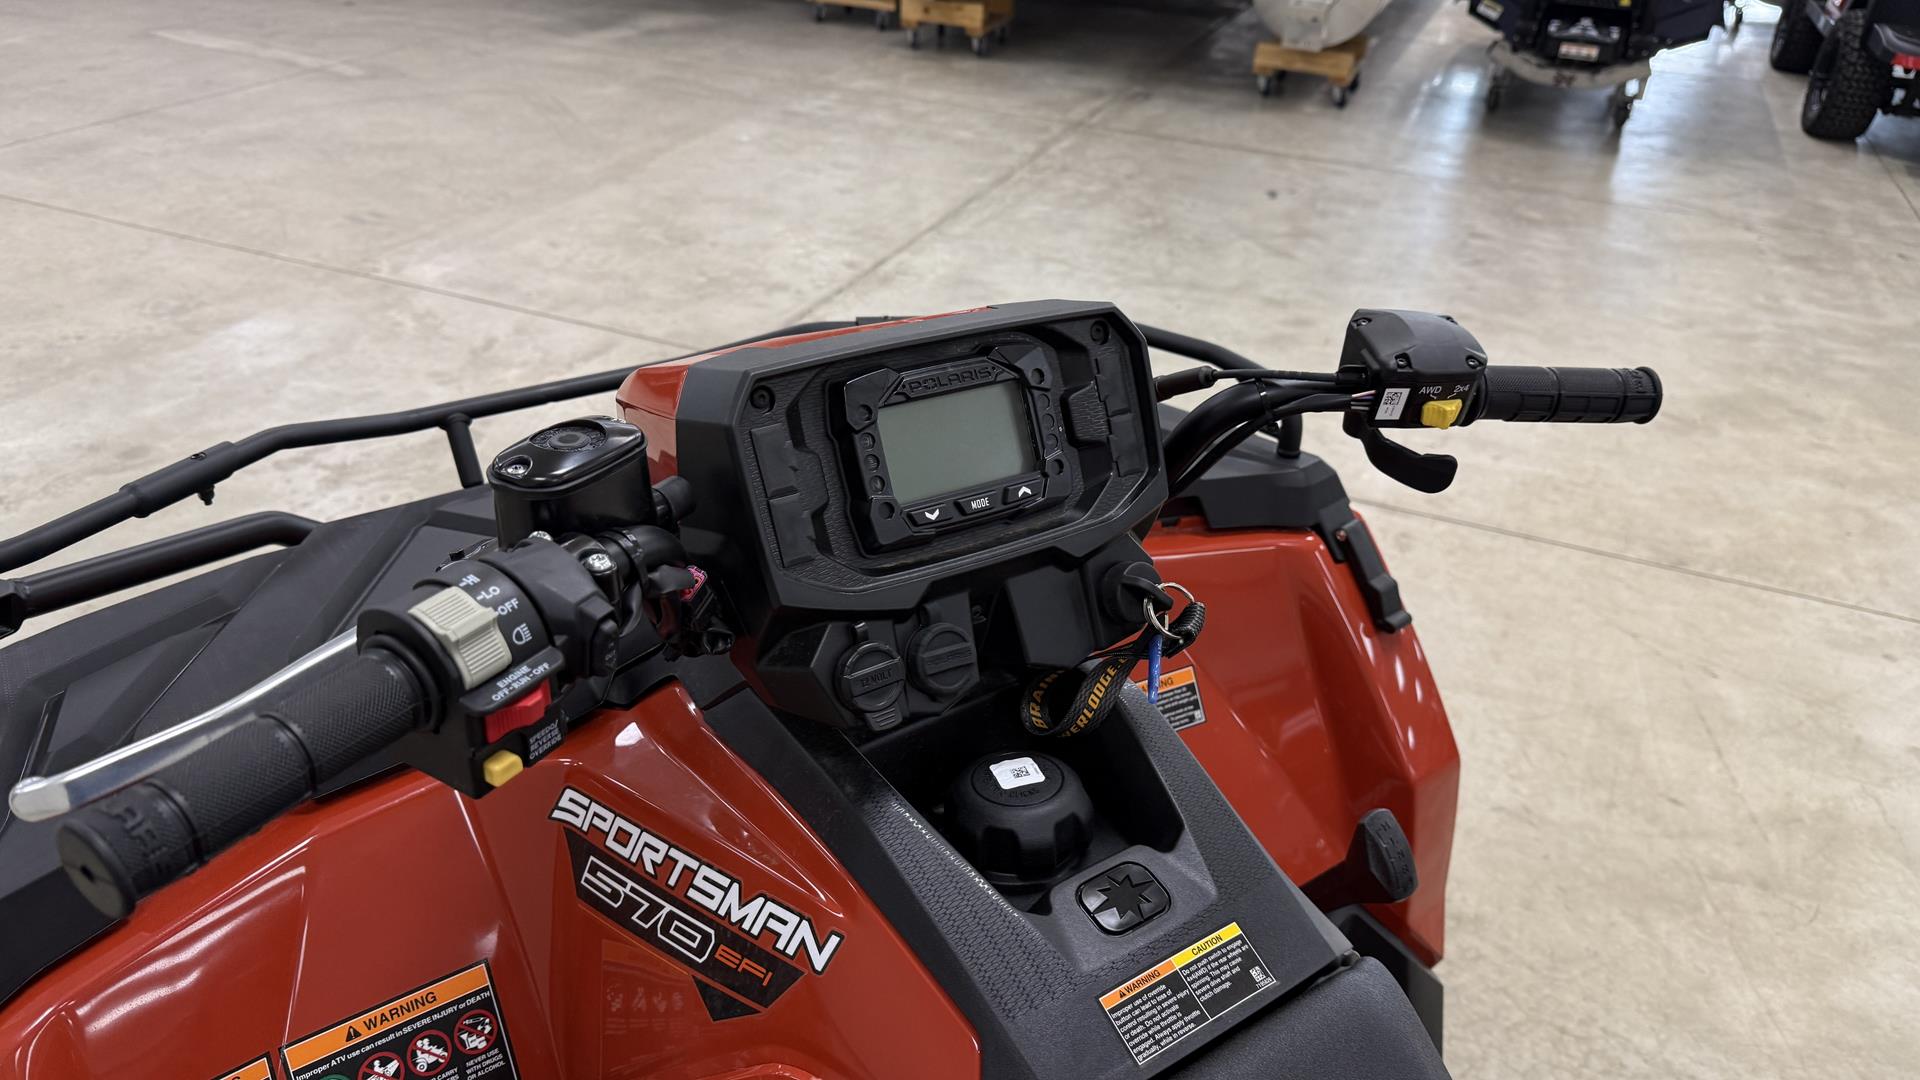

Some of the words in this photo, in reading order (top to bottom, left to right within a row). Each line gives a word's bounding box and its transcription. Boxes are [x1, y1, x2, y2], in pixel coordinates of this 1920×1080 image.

[909, 366, 992, 393] POLARIS
[1419, 385, 1442, 395] AWD
[1453, 384, 1470, 394] 2x4
[971, 497, 990, 511] MODE
[481, 586, 500, 599] LO
[497, 598, 519, 615] OFF
[496, 666, 532, 688] ENGINE
[551, 788, 842, 973] SPORTSMAN
[580, 856, 716, 963] 570
[714, 944, 773, 986] EFI
[1191, 934, 1222, 955] CAUTION
[1196, 958, 1208, 967] push
[1207, 949, 1221, 961] switch
[1226, 939, 1242, 951] engage
[1226, 947, 1241, 958] wheels
[1209, 968, 1220, 977] This
[1219, 964, 1229, 973] may
[1229, 957, 1241, 966] cause
[1124, 969, 1160, 993] WARNING
[1194, 984, 1210, 995] severe
[1209, 977, 1220, 986] drive
[1220, 970, 1231, 980] shaft
[1231, 965, 1240, 973] and
[1111, 1003, 1133, 1018] Improper
[1146, 983, 1166, 997] override
[1199, 991, 1213, 1001] clutch
[362, 991, 438, 1031] WARNING
[1115, 1013, 1131, 1025] button
[1131, 1008, 1141, 1016] can
[1140, 1001, 1151, 1010] lead
[1156, 992, 1166, 1001] loss
[1119, 1019, 1137, 1032] control
[1136, 1007, 1157, 1023] resulting
[1161, 996, 1176, 1007] severe
[1175, 987, 1189, 999] injury
[1129, 1023, 1145, 1035] death.
[1144, 1018, 1153, 1026] Do
[1152, 1014, 1161, 1022] not
[1160, 1003, 1179, 1017] activate
[296, 1063, 330, 1080] Improper
[330, 1054, 347, 1067] ATV
[347, 1050, 361, 1060] use
[361, 1042, 375, 1054] can
[374, 1033, 396, 1048] result
[395, 1030, 403, 1040] in
[402, 1016, 432, 1034] SEVERE
[432, 1005, 458, 1023] INJURY
[458, 1002, 466, 1010] or
[465, 990, 491, 1006] DEATH
[1127, 1031, 1148, 1046] override
[1147, 1023, 1160, 1034] while
[1159, 1014, 1177, 1026] throttle
[1132, 1037, 1155, 1054] engaged.
[1153, 1026, 1172, 1040] Always
[1170, 1019, 1184, 1030] apply
[1183, 1009, 1200, 1021] throttle
[1159, 1035, 1172, 1046] while
[465, 1053, 486, 1067] NEVER
[486, 1048, 500, 1058] USE
[465, 1065, 481, 1075] WITH
[481, 1053, 503, 1067] DRUGS
[477, 1060, 506, 1077] ALCOHOL
[436, 1067, 458, 1080] CARRY
